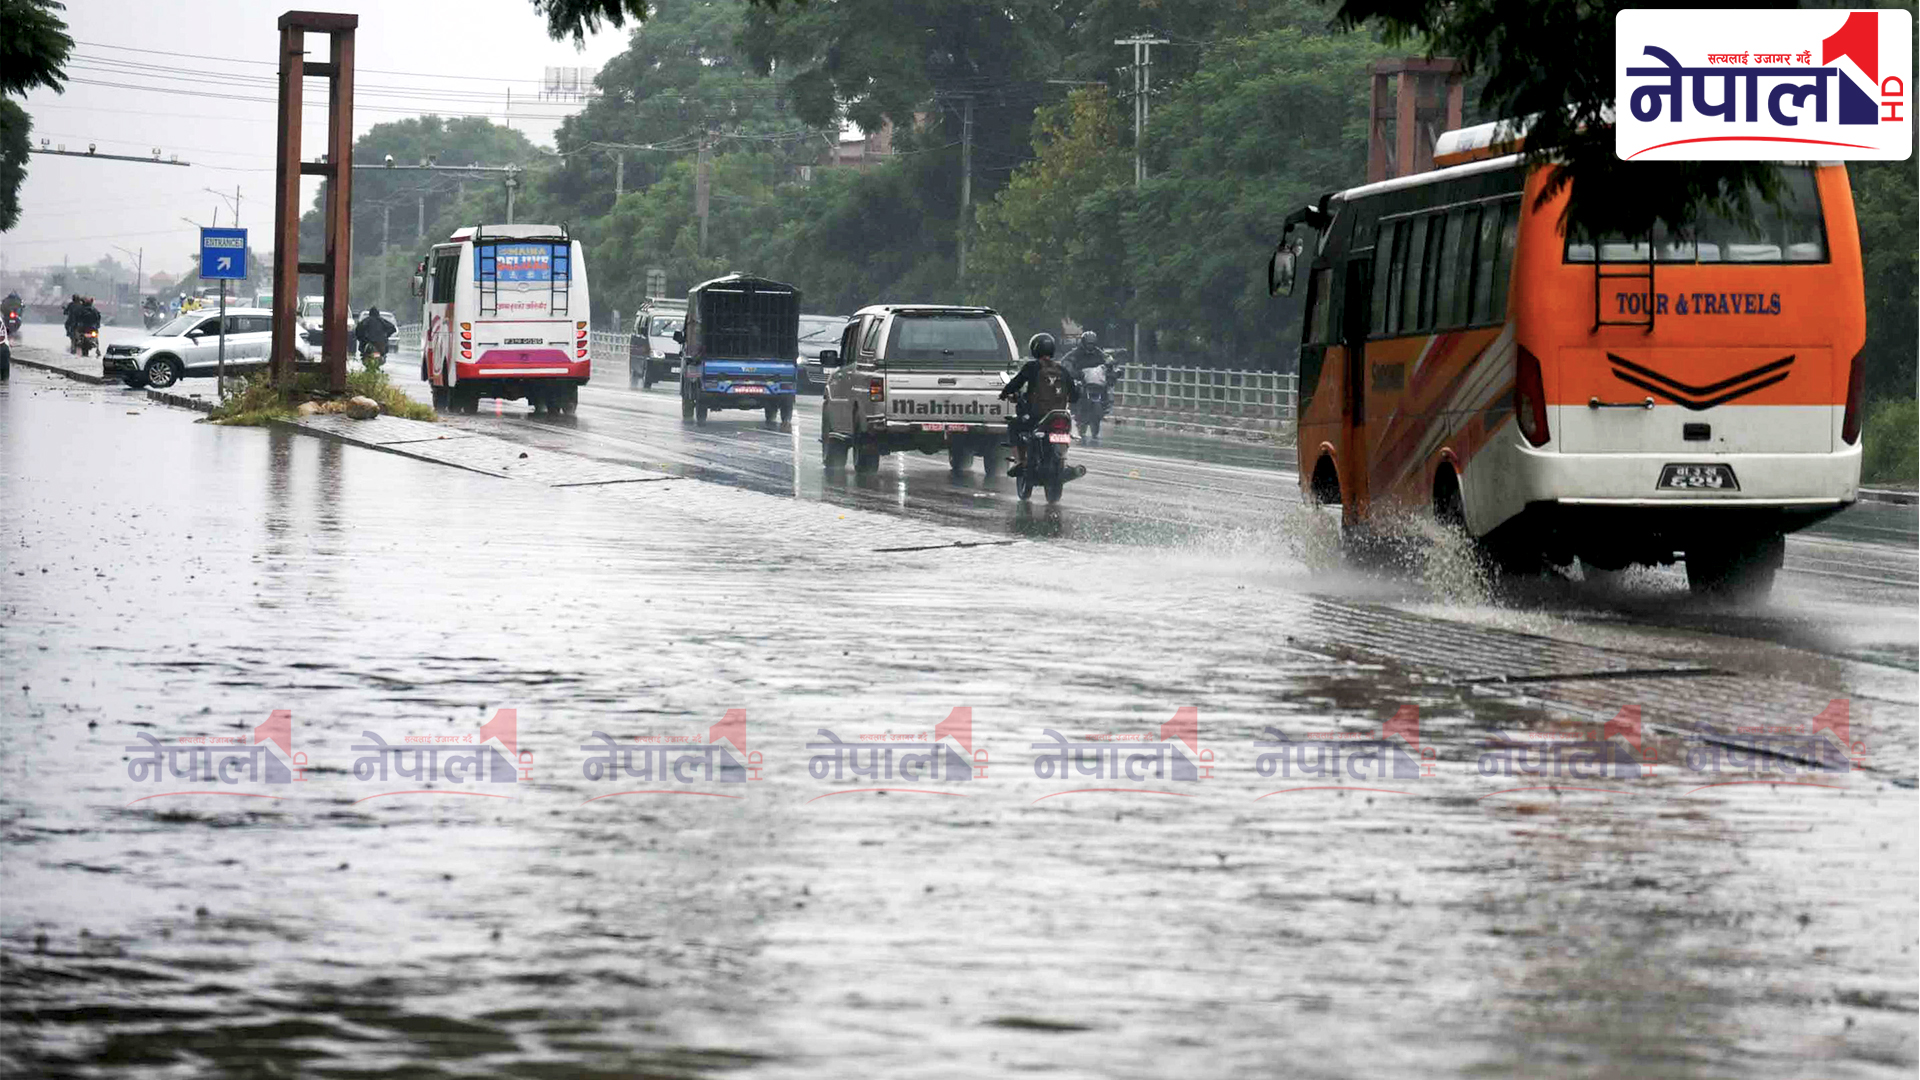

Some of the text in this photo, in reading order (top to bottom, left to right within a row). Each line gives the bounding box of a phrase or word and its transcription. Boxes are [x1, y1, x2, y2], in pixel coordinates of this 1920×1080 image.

[1616, 293, 1781, 315] TOUR & TRAVELS
[892, 400, 1001, 415] Mahindra
